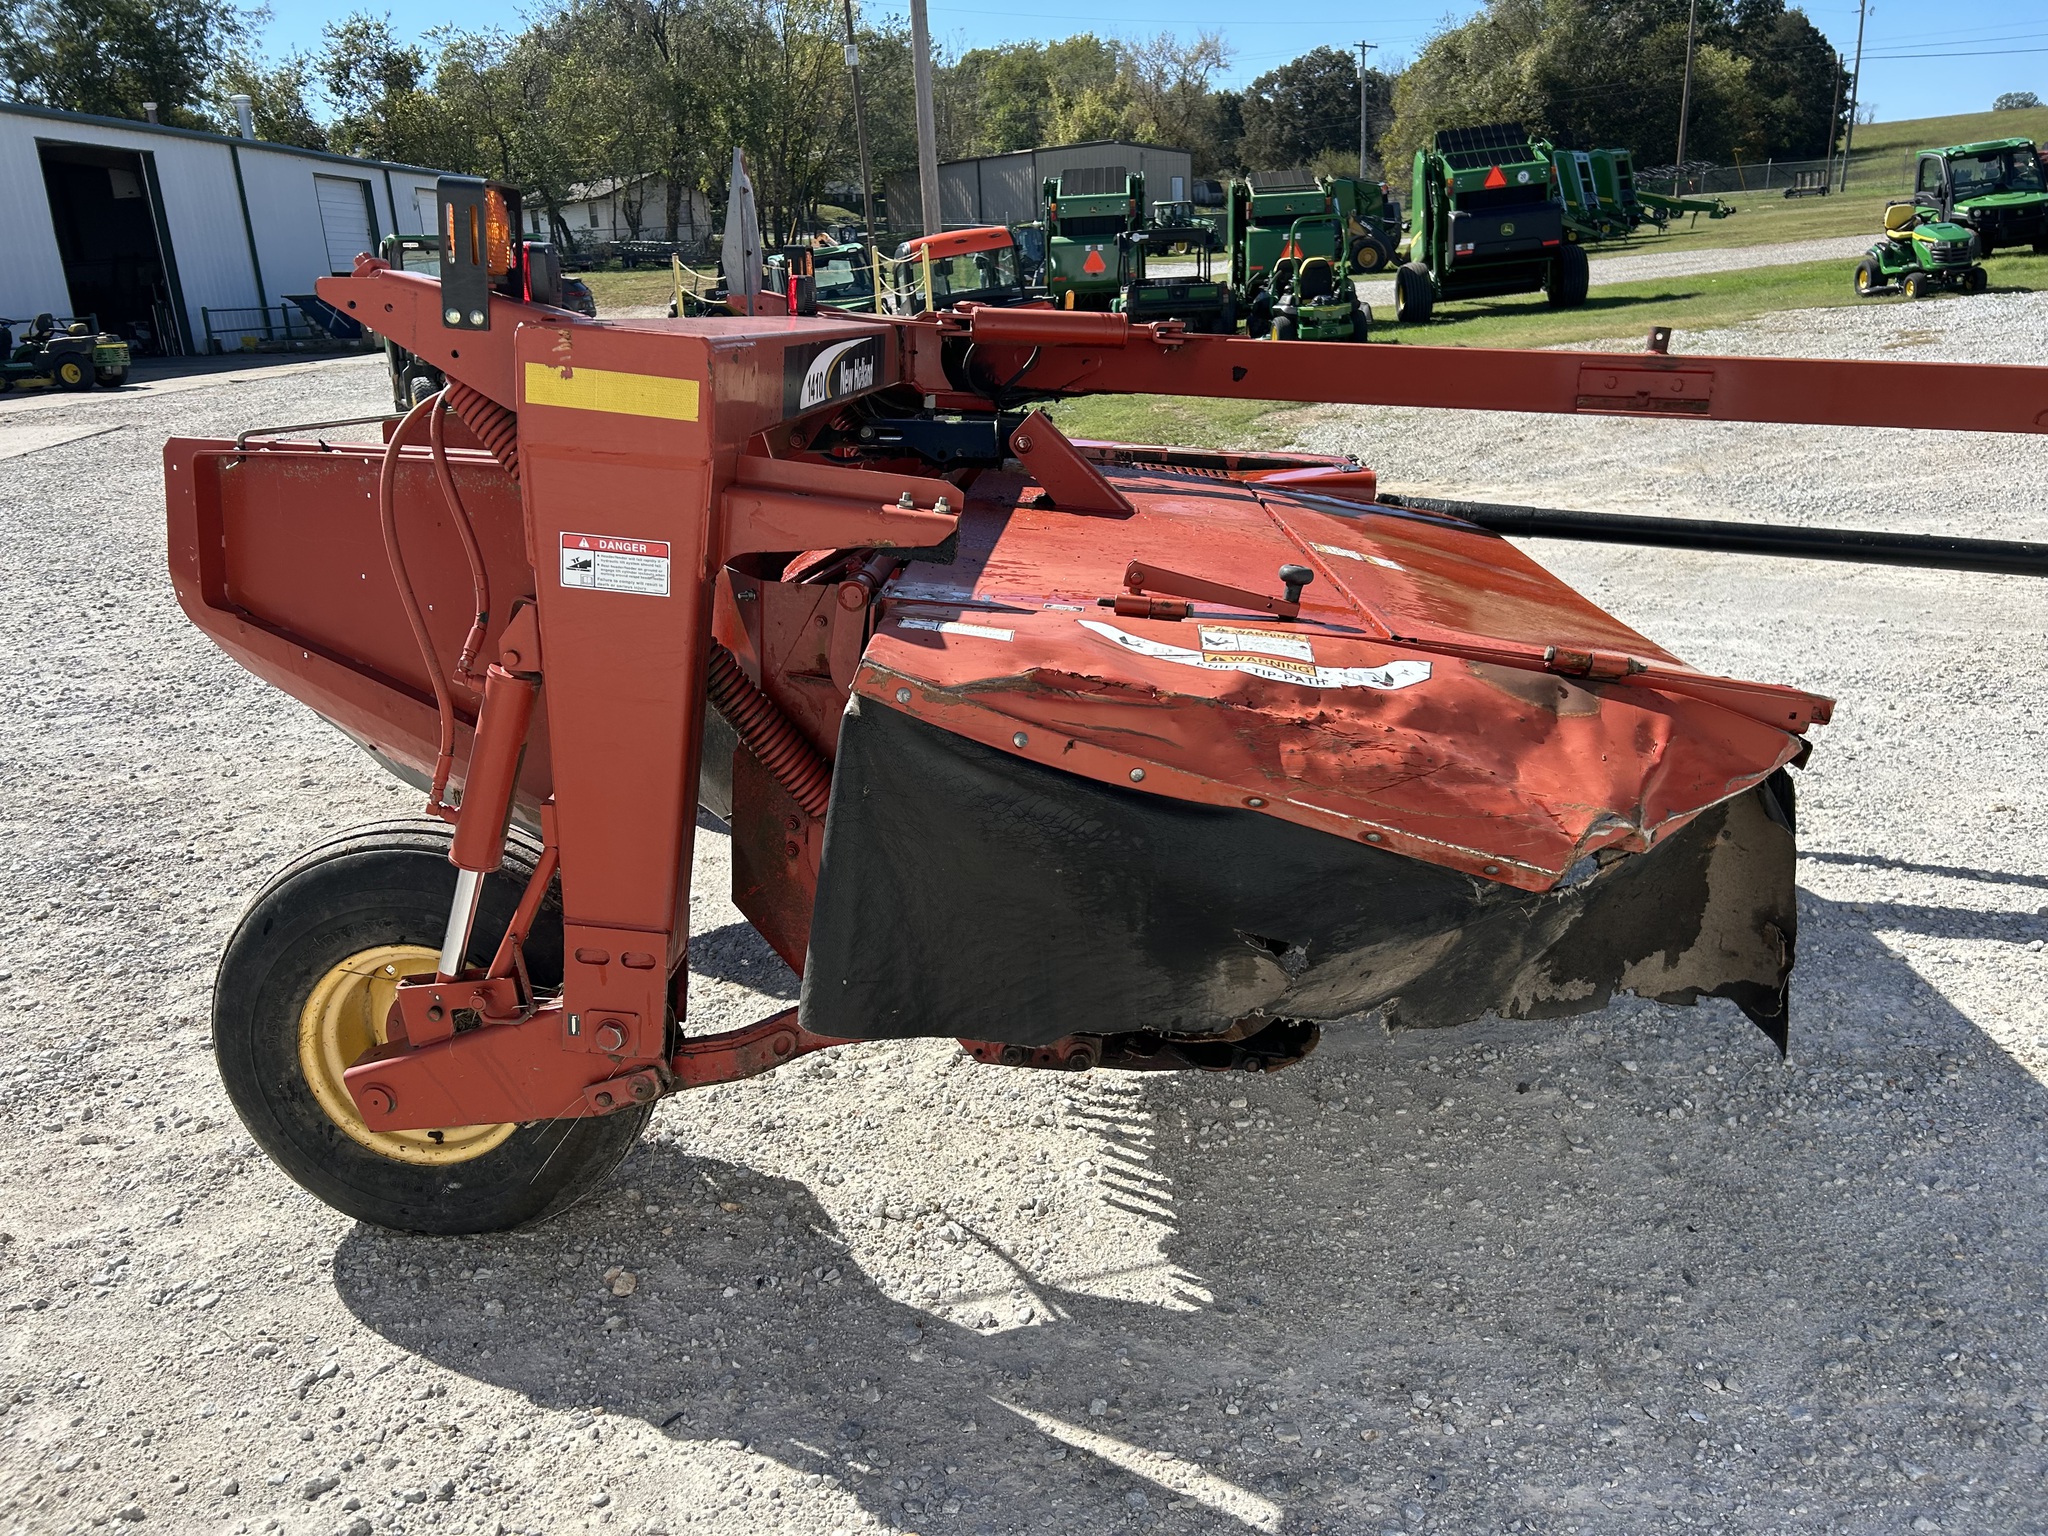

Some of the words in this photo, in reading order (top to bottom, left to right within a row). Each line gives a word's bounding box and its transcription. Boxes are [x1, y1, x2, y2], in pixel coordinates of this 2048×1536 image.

[808, 371, 824, 402] 1410
[840, 360, 854, 395] New
[599, 540, 647, 553] DANGER
[1229, 656, 1310, 674] WARNING
